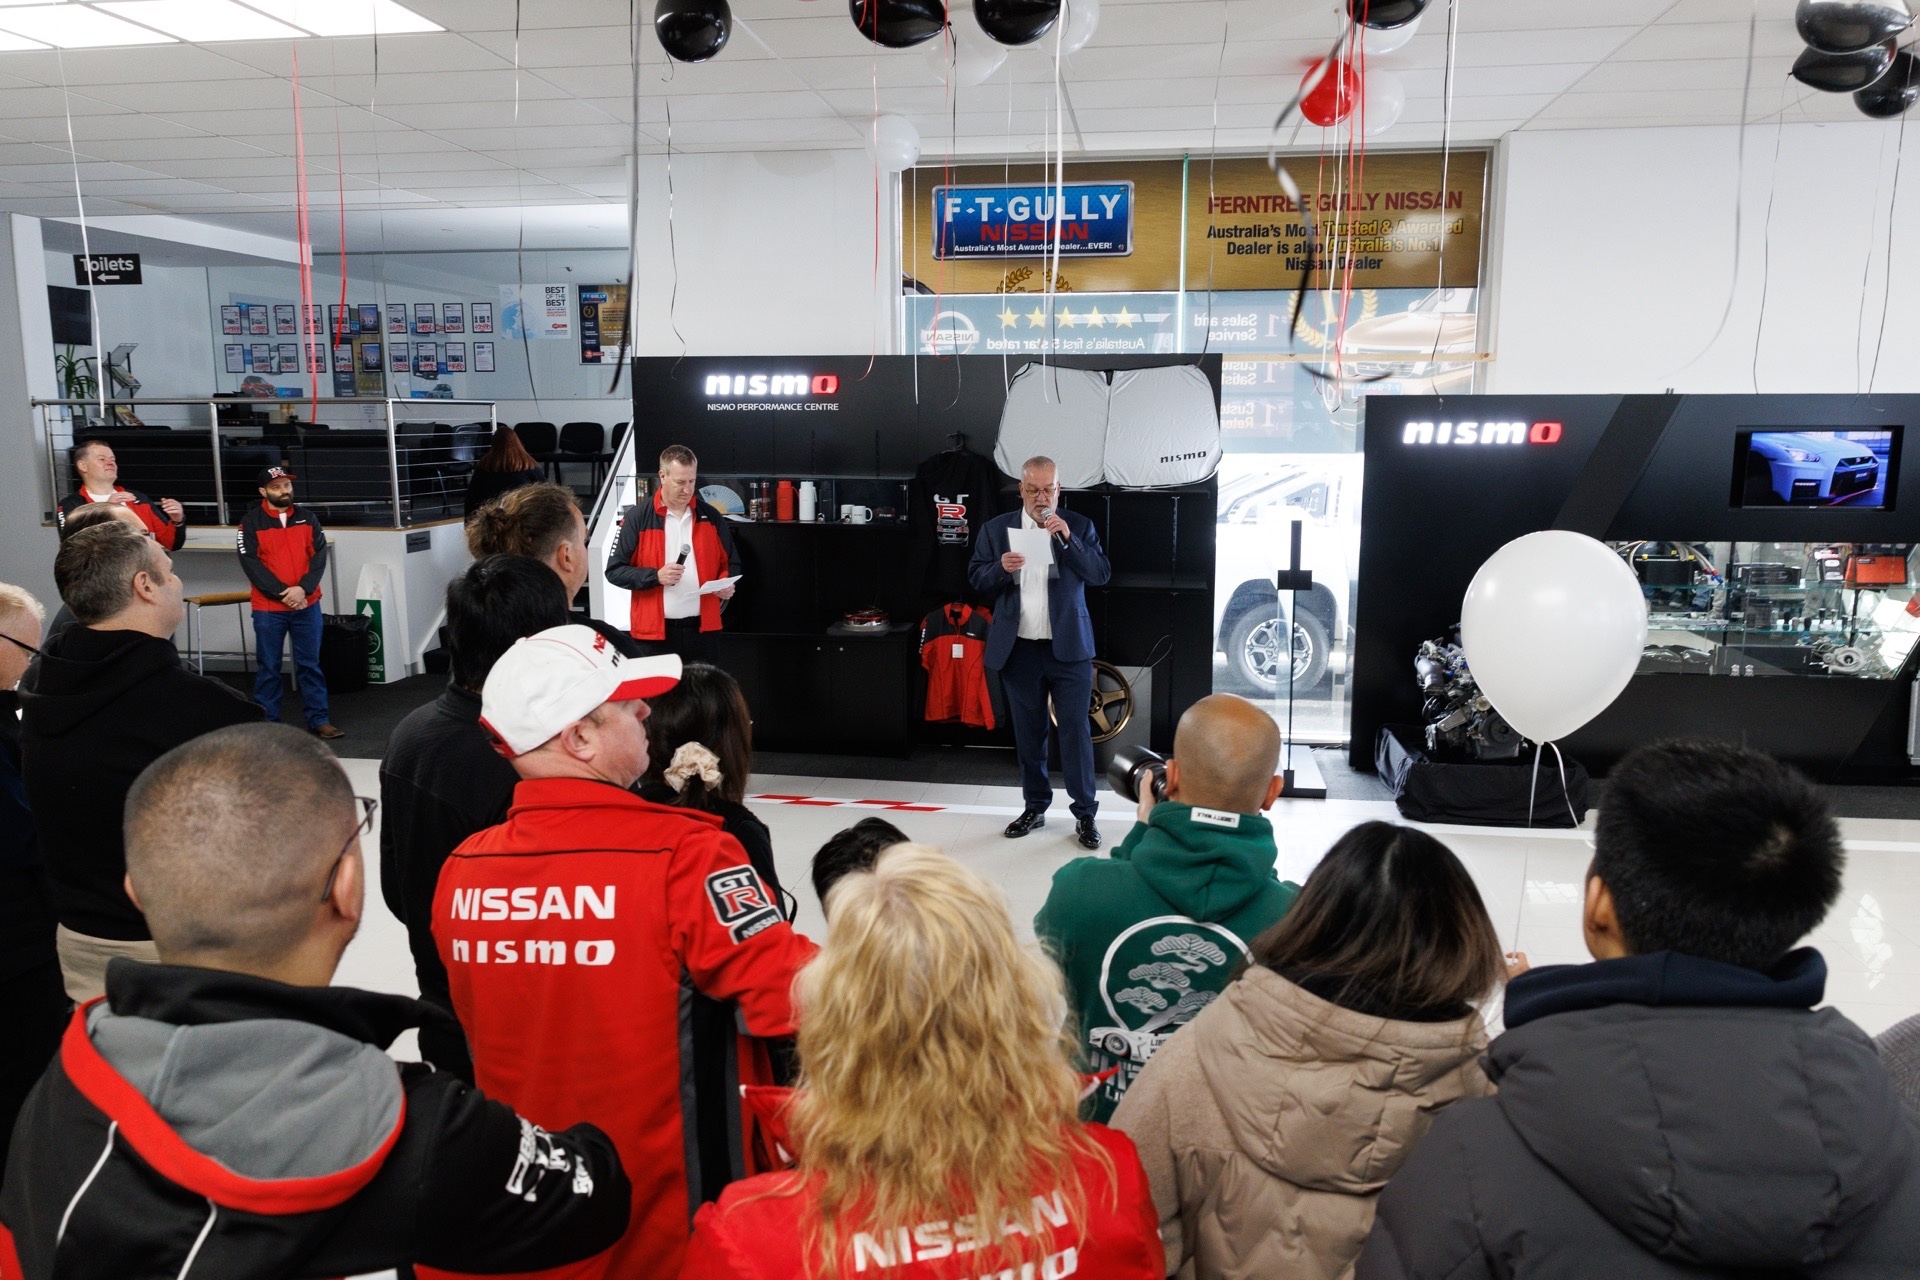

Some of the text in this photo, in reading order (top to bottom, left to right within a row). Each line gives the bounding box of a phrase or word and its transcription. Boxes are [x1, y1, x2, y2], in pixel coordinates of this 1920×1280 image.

[1385, 190, 1463, 210] NISSAN
[980, 222, 1089, 242] NISSAN
[1055, 242, 1113, 251] ealer...EVER!
[1226, 241, 1274, 255] Dealer
[1276, 241, 1290, 254] is
[79, 256, 135, 272] Toilets
[545, 286, 566, 294] BEST
[545, 299, 567, 307] BEST
[704, 374, 840, 396] nismo
[706, 402, 840, 411] NISMO PERFORMANCE CENTRE
[1402, 421, 1563, 445] nismo
[1160, 450, 1208, 464] nismo
[450, 884, 617, 921] NISSAN
[451, 938, 617, 966] nismo
[852, 1189, 1070, 1273] NISSAN
